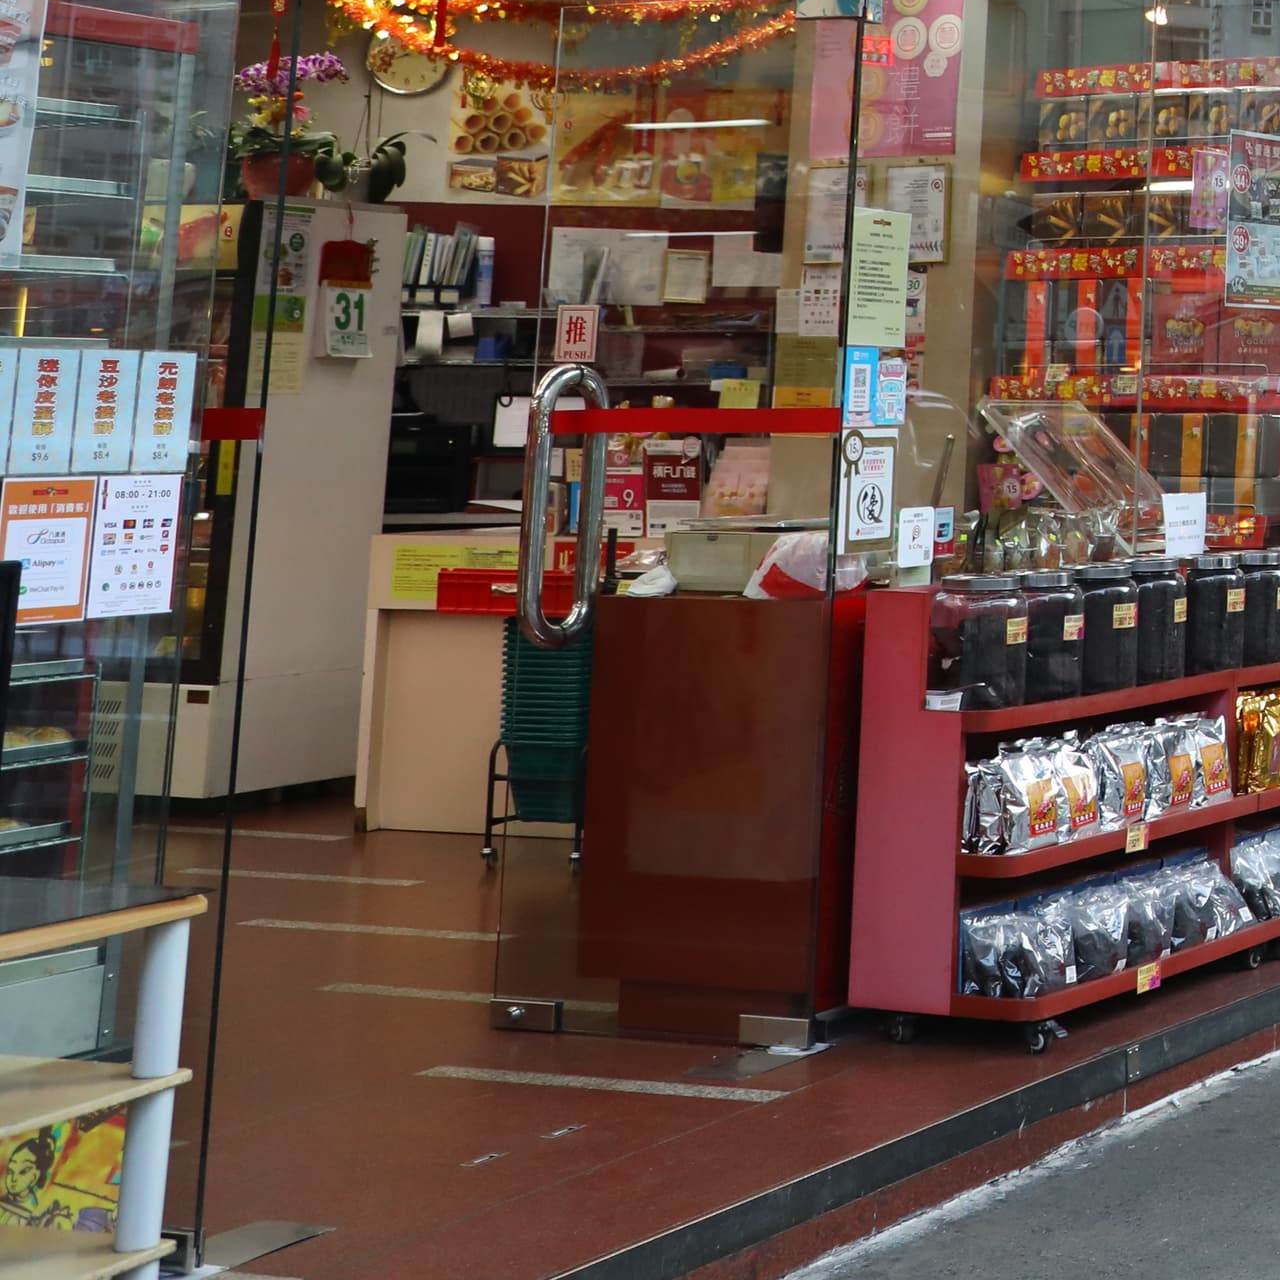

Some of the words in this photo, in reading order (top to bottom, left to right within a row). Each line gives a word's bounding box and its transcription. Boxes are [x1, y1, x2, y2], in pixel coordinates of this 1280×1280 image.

[335, 292, 365, 331] 31
[564, 315, 587, 345] 推
[563, 350, 588, 360] PUSH
[93, 359, 120, 437] 豆沙老婆餅
[152, 362, 179, 437] 元朗老婆餅
[31, 452, 49, 463] $9.6
[115, 490, 140, 499] 08:00
[148, 489, 172, 498] 21:00
[32, 558, 56, 568] Alipay
